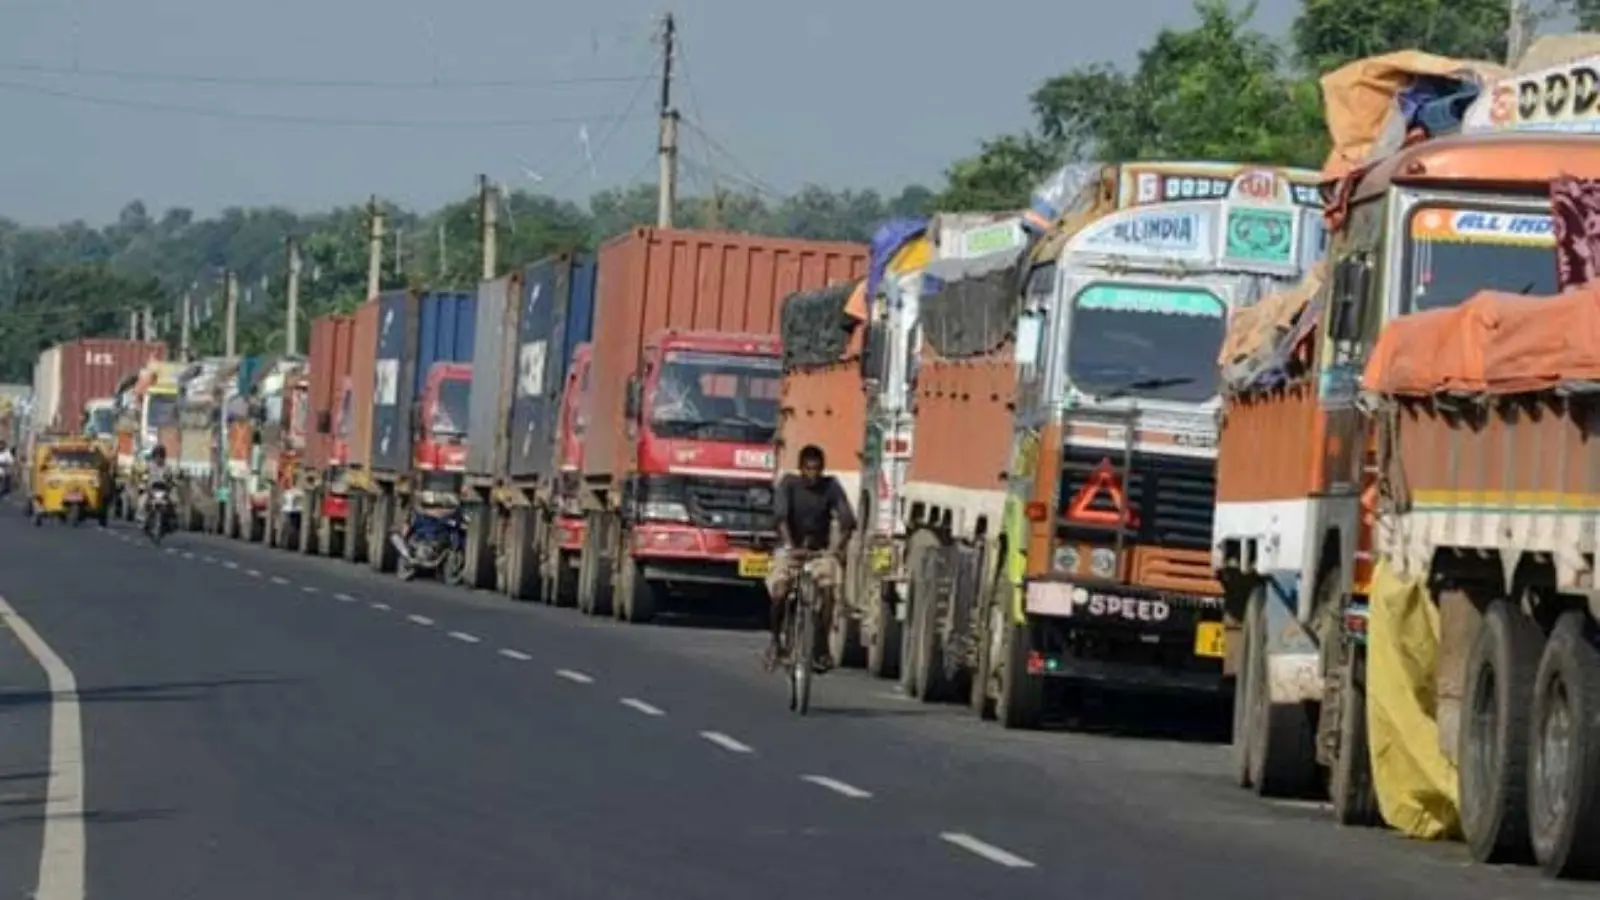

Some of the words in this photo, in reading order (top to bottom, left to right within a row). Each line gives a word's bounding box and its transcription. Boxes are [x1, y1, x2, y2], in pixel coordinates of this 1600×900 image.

[1490, 67, 1600, 125] GOOD
[1143, 215, 1193, 243] INDIA
[1508, 217, 1554, 234] IND
[1089, 594, 1170, 620] SPEED
